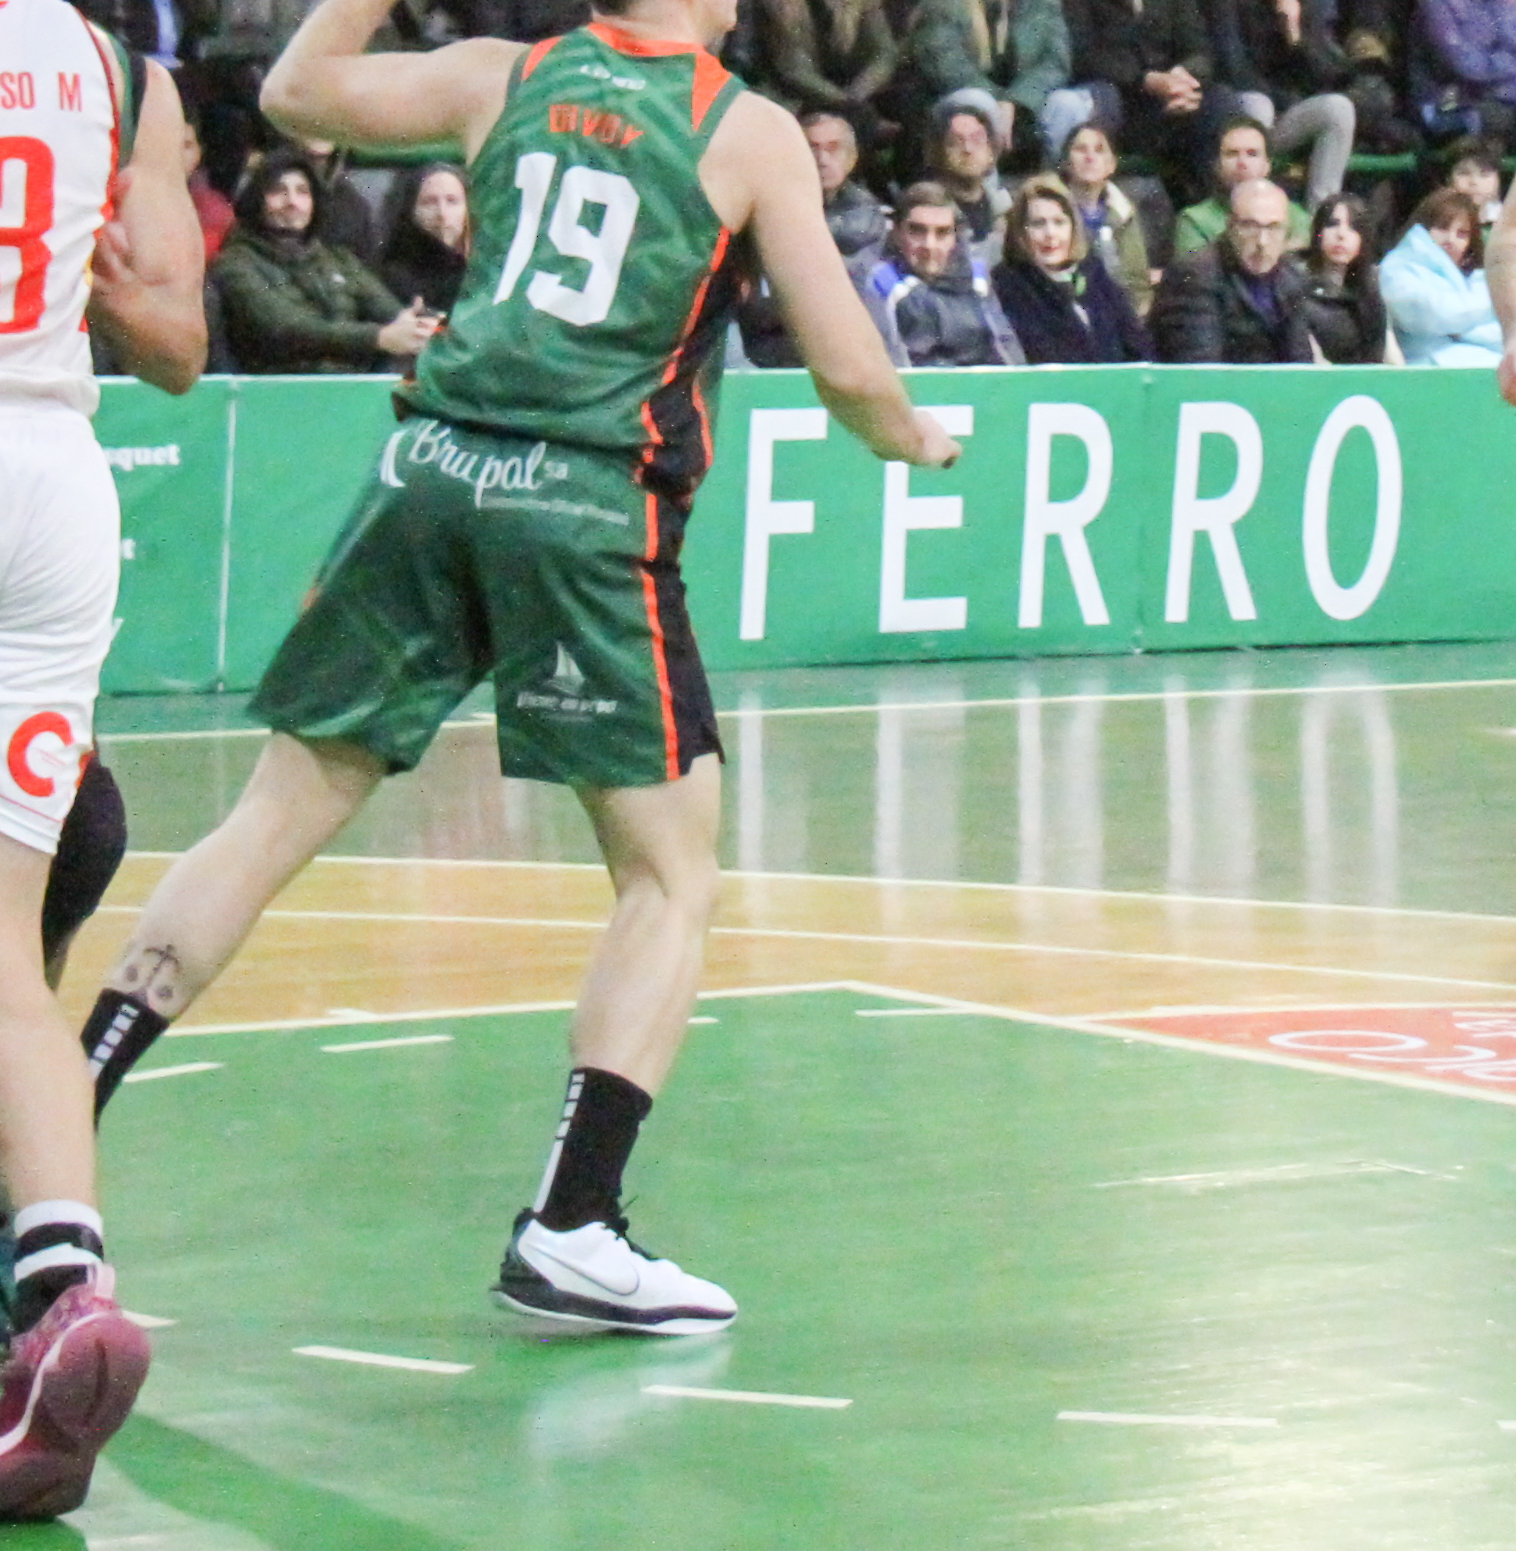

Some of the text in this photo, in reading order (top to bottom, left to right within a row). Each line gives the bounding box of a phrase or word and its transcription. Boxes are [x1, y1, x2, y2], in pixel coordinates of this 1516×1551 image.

[58, 71, 84, 113] M
[492, 151, 640, 326] 19
[739, 394, 1403, 640] FERRO
